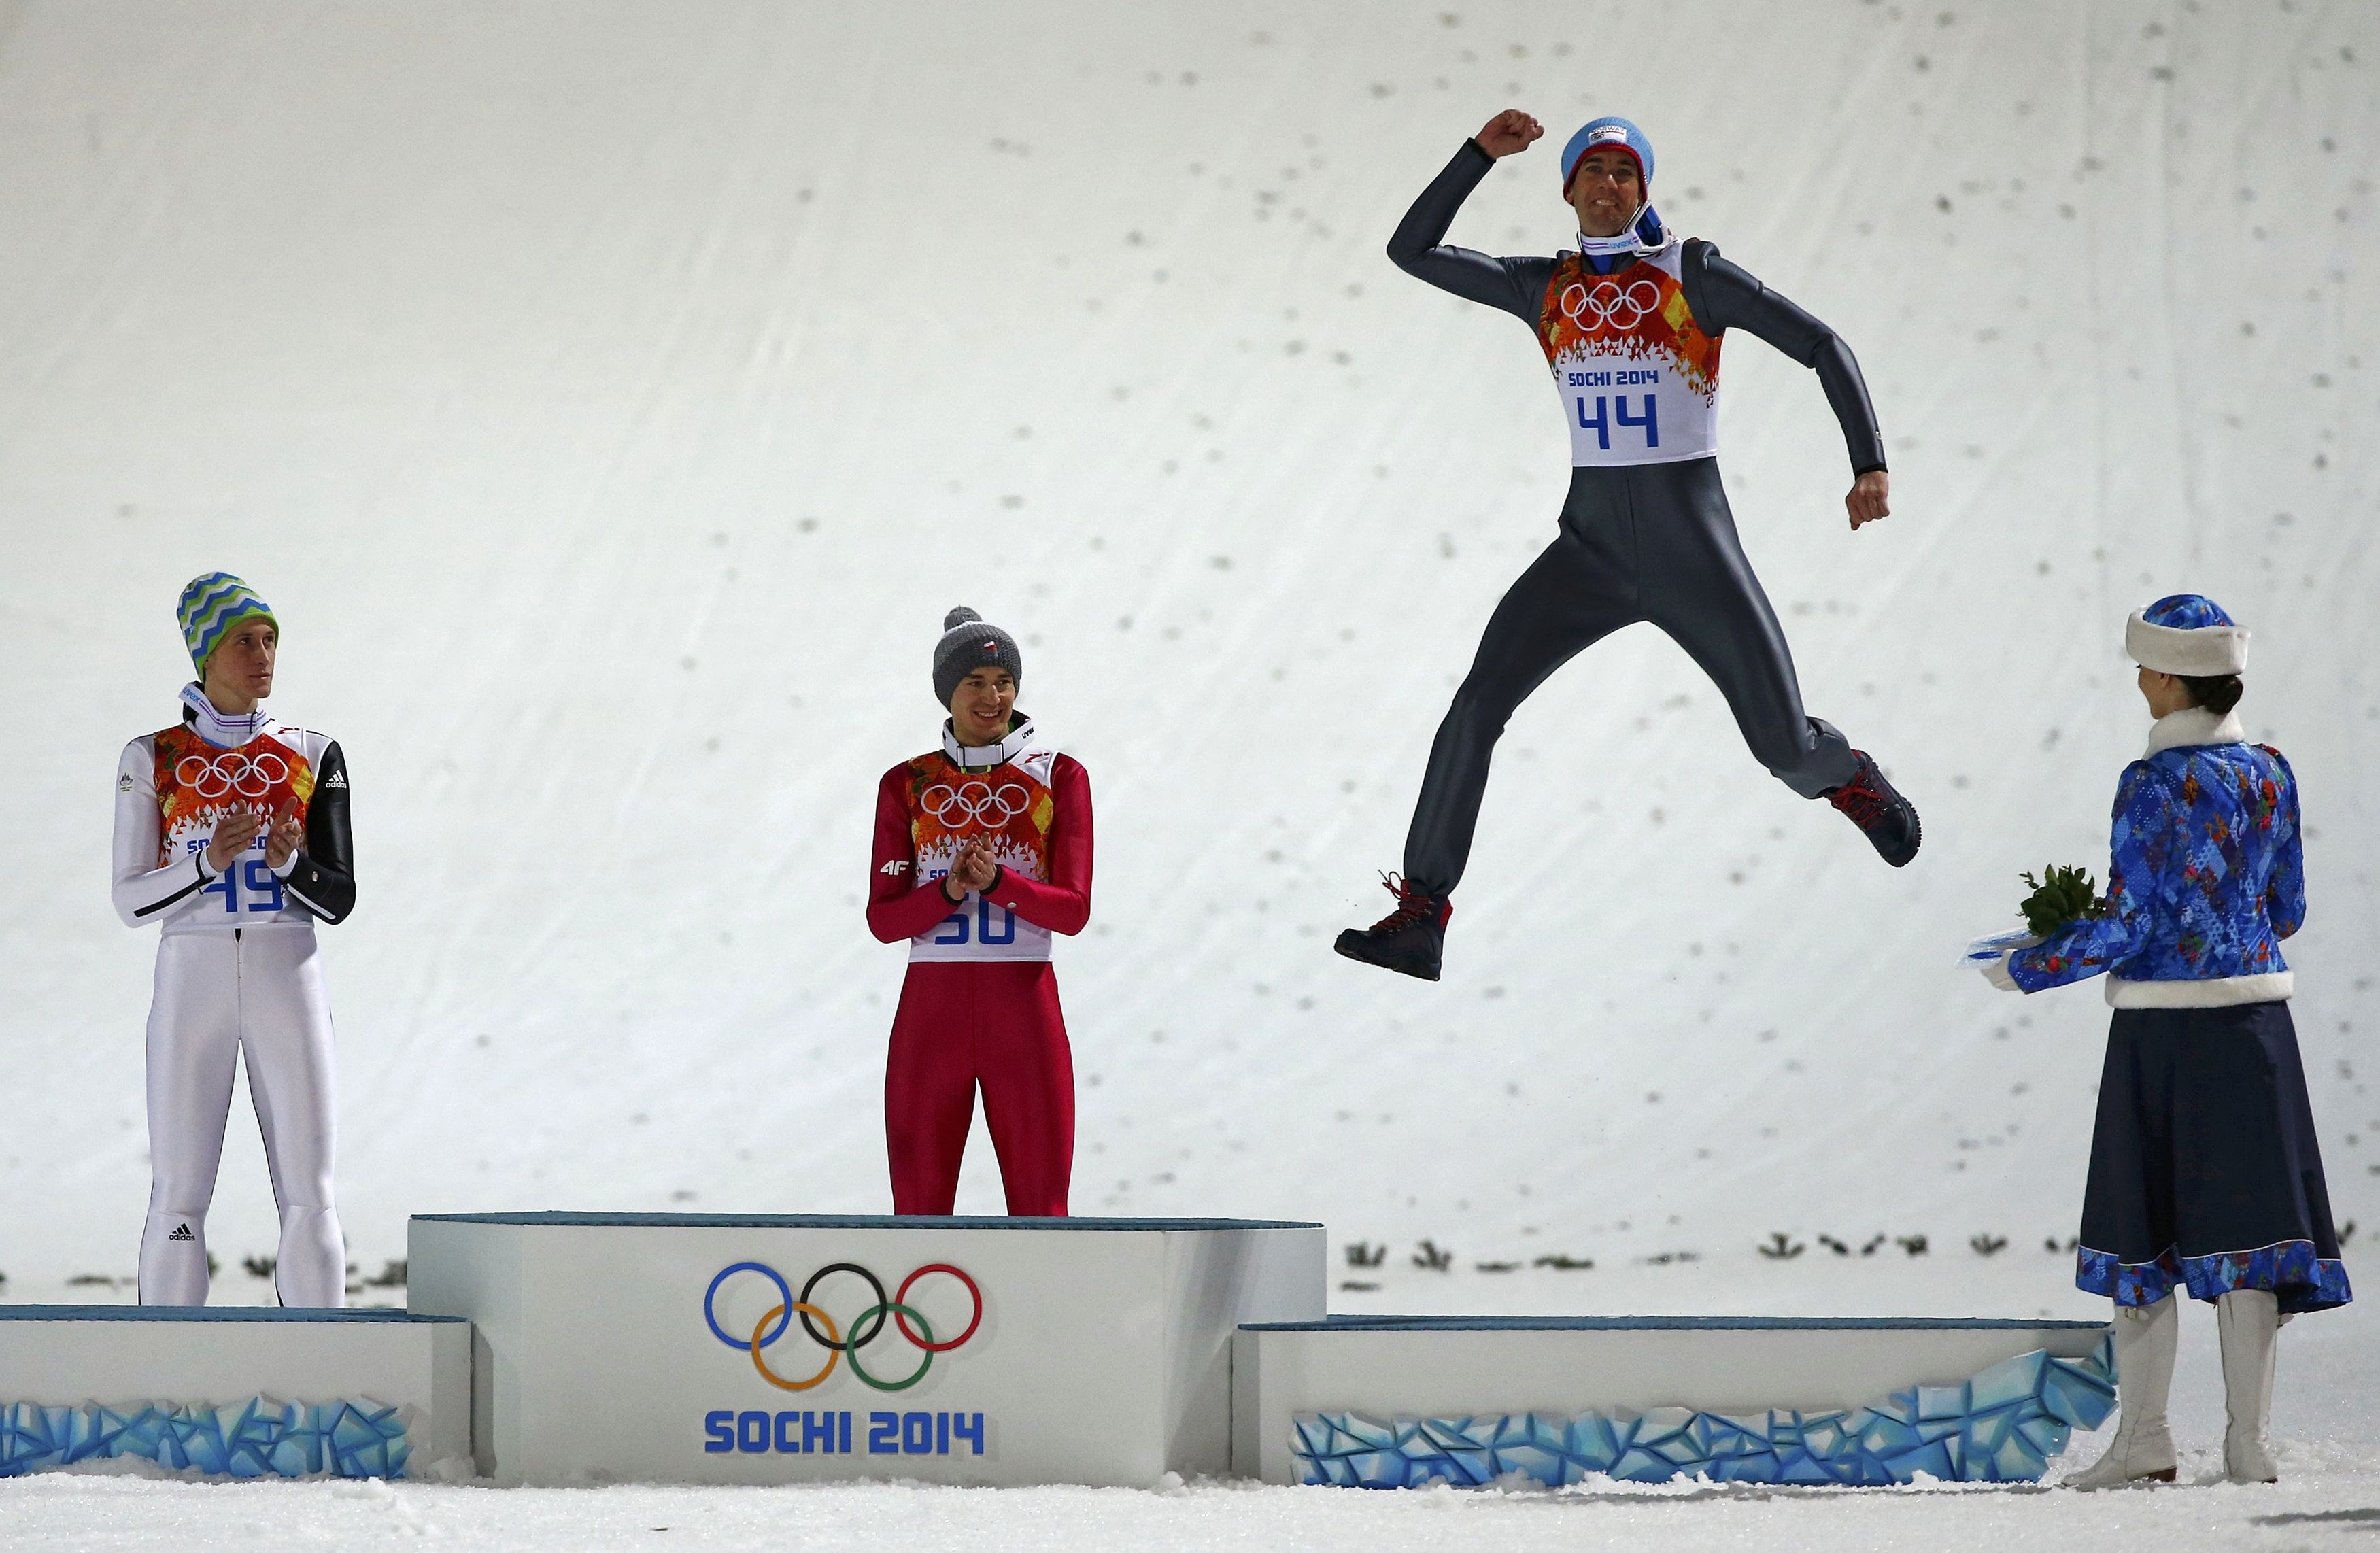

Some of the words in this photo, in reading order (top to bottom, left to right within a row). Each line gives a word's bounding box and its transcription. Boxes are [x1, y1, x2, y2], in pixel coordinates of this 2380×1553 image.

[1610, 239, 1633, 249] uvex
[1569, 372, 1611, 386] SOCHI
[1616, 370, 1659, 385] 2014
[1577, 394, 1659, 449] 44
[183, 687, 200, 703] uvex
[880, 860, 909, 876] 4F
[203, 860, 283, 912] 49
[935, 893, 1015, 944] 50
[704, 1410, 851, 1454] SOCHI
[869, 1412, 984, 1454] 2014
